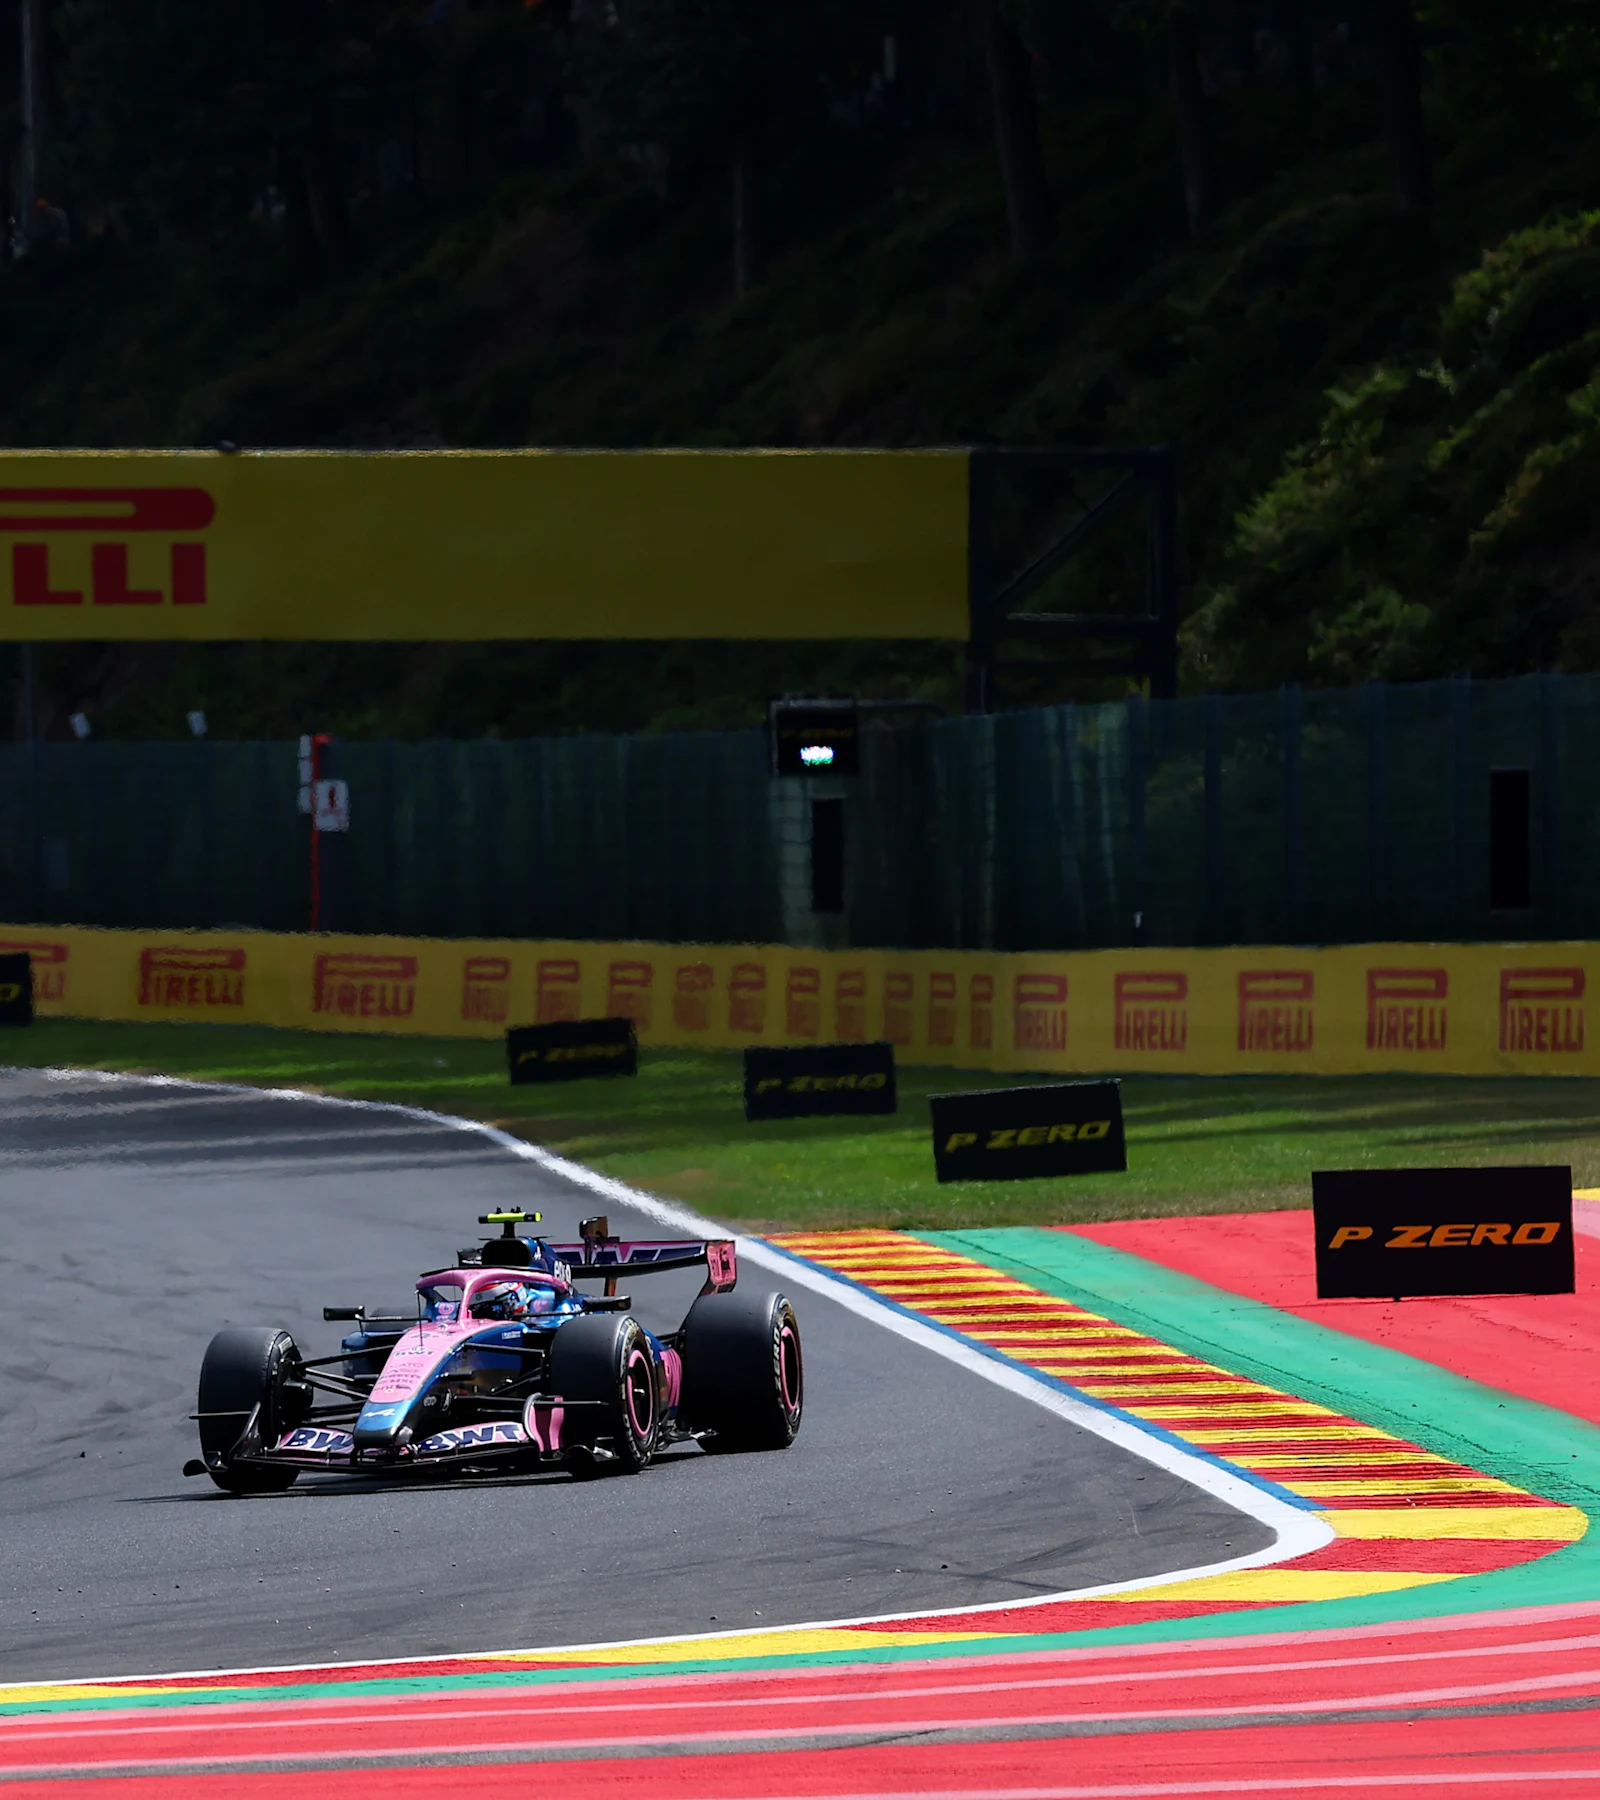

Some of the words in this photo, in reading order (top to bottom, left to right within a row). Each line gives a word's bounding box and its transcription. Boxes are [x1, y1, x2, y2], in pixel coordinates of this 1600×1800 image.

[138, 948, 246, 1005] PIRELLI
[1366, 967, 1447, 1050] PIRELLI
[1499, 967, 1585, 1052] PIRELLI
[944, 1132, 979, 1154] P
[985, 1119, 1111, 1150] ZERO
[1328, 1225, 1374, 1250] P
[1384, 1221, 1562, 1249] ZERO
[286, 1429, 355, 1449] BW
[420, 1425, 520, 1450] BWT
